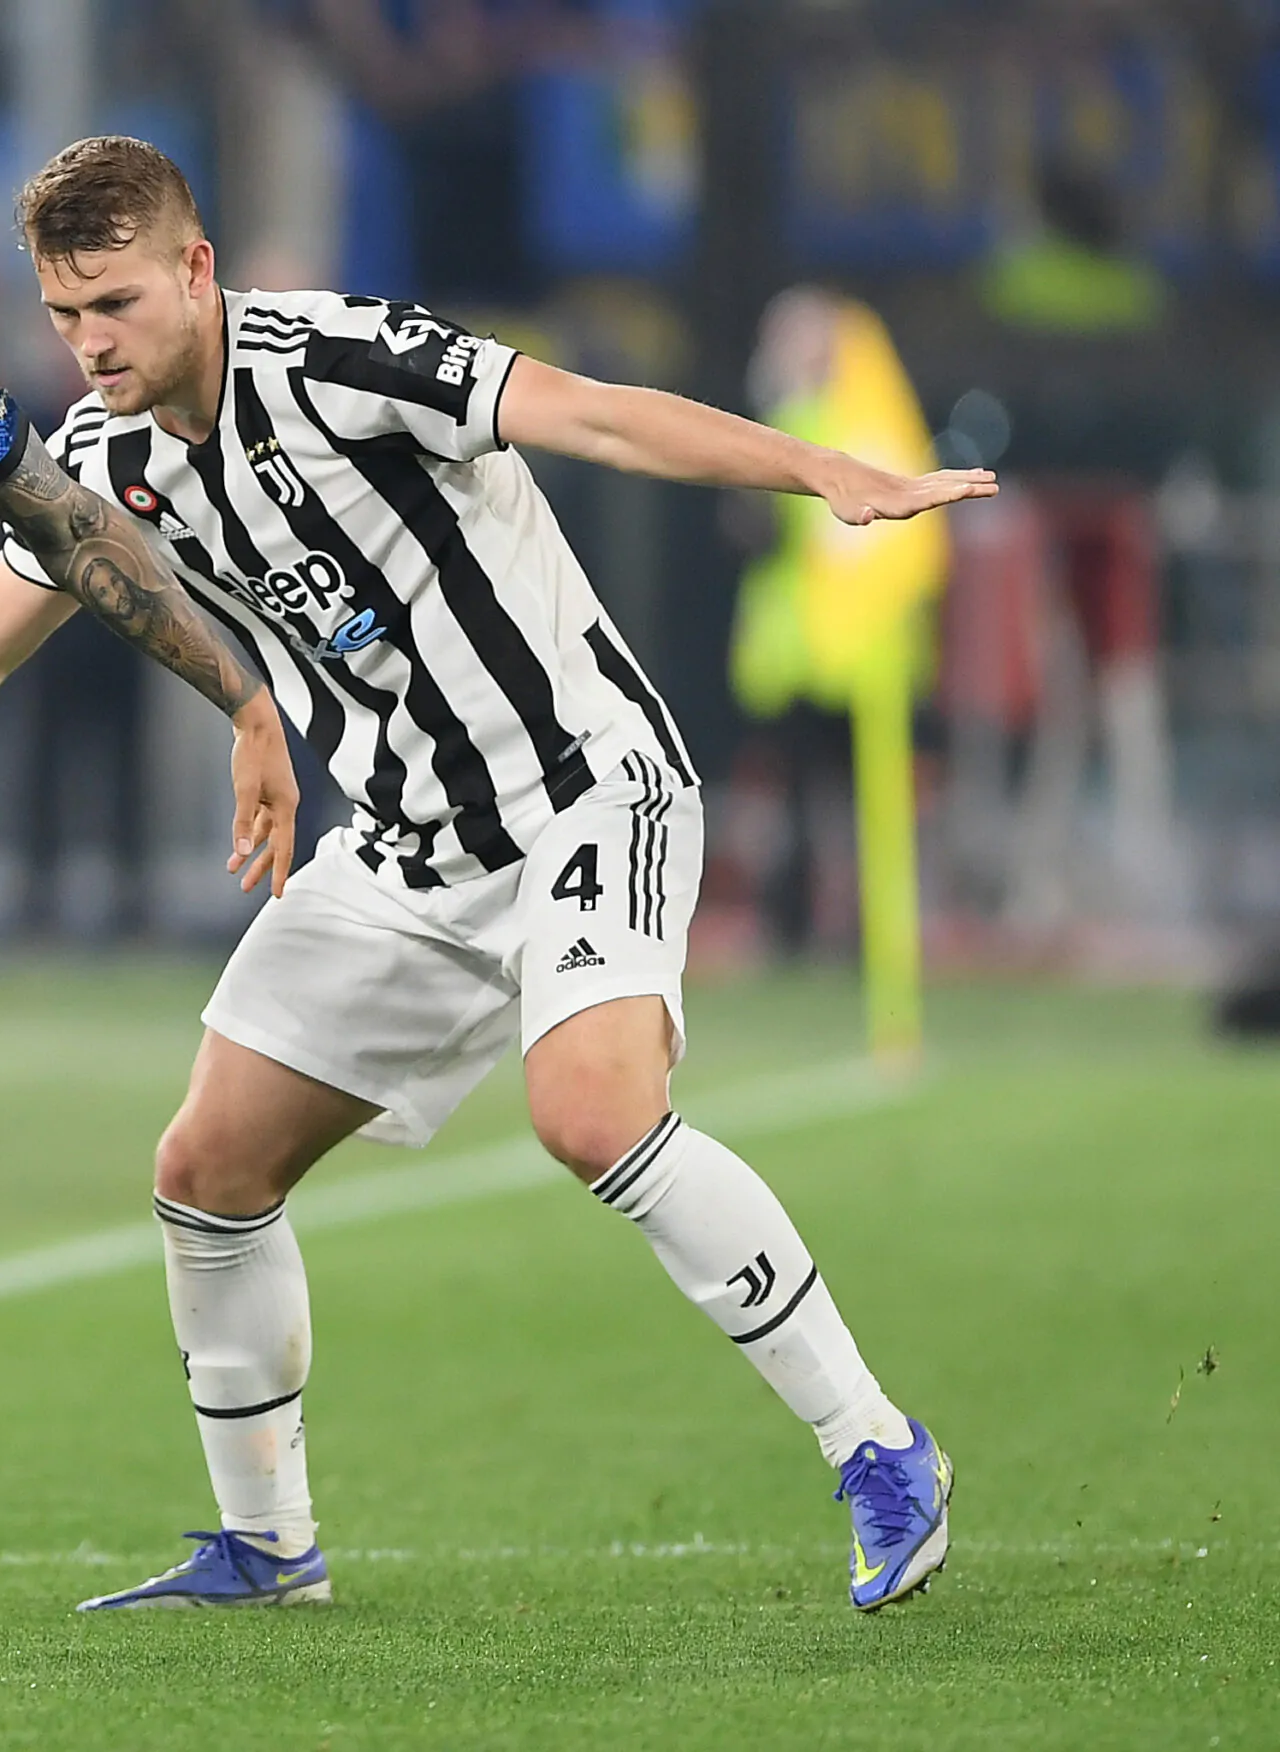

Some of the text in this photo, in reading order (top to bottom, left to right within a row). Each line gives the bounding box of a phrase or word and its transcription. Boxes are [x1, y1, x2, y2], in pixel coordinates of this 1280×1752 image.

[435, 334, 484, 387] Bitg
[550, 843, 604, 911] 4
[555, 955, 606, 974] adidas
